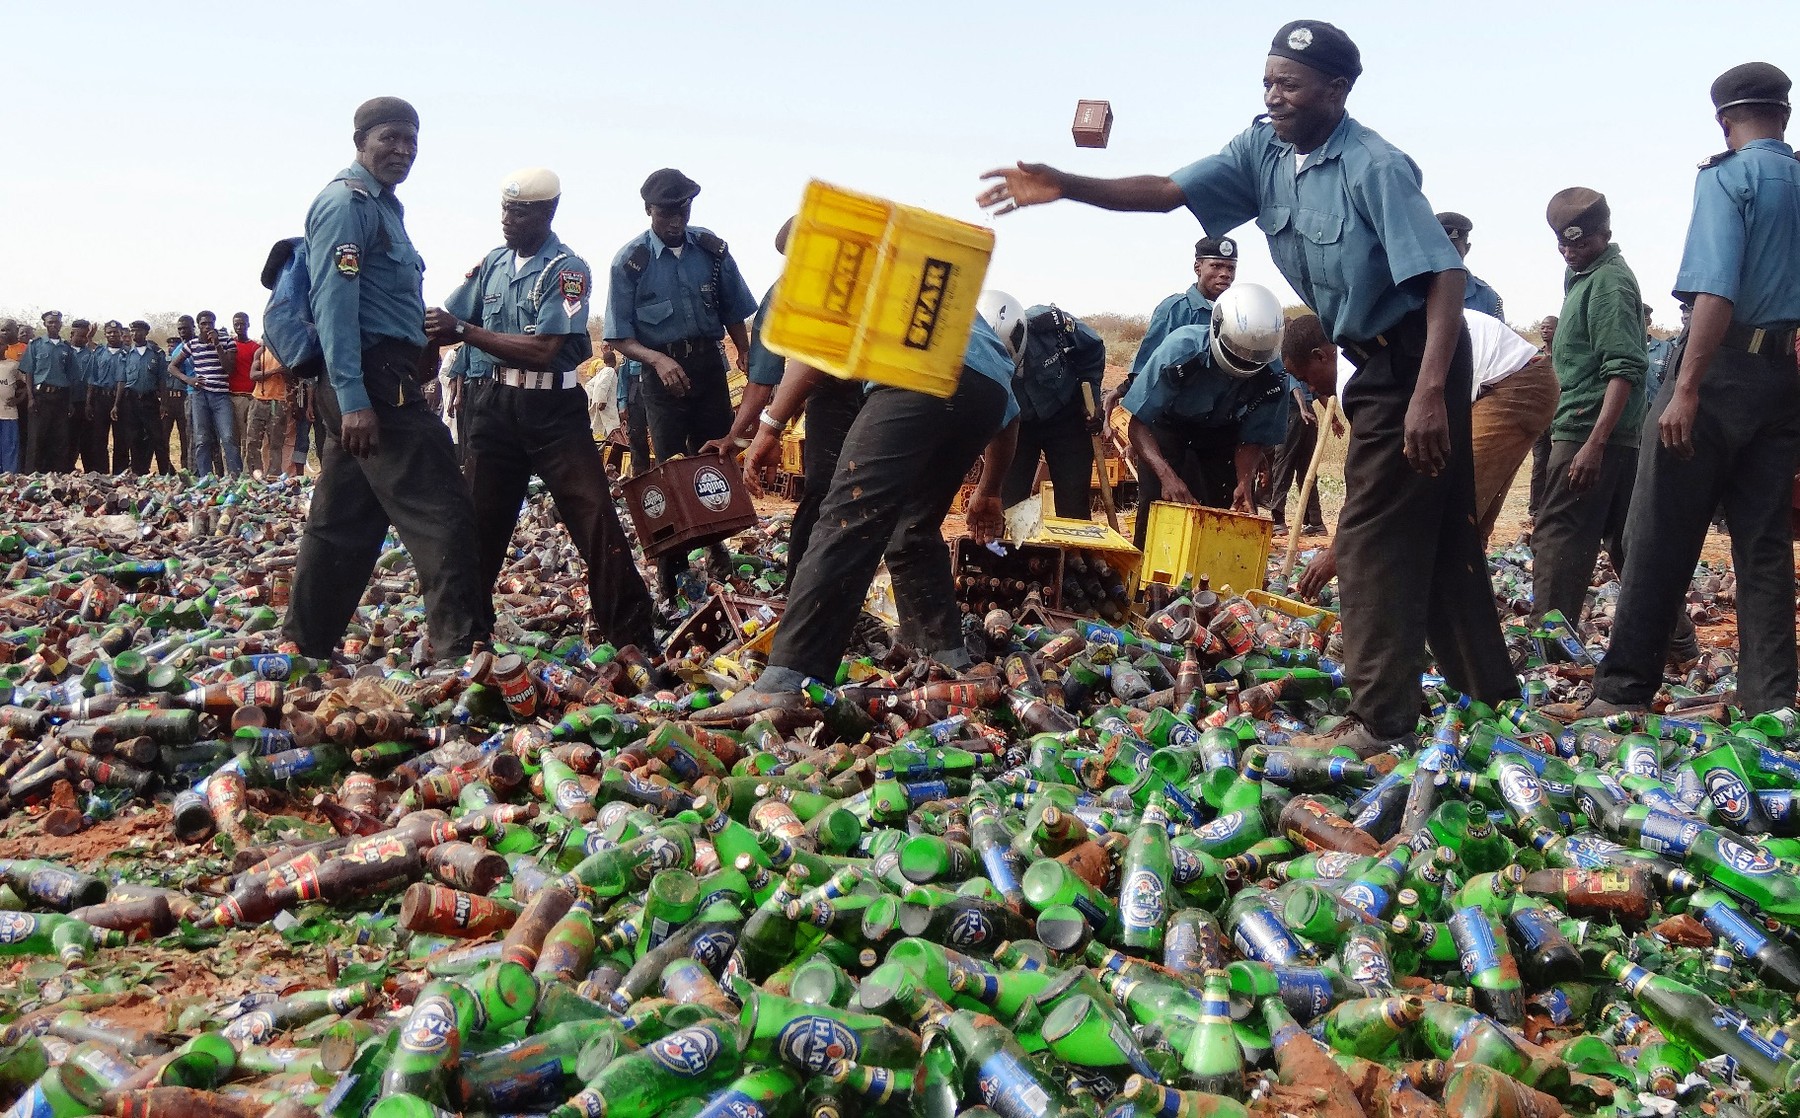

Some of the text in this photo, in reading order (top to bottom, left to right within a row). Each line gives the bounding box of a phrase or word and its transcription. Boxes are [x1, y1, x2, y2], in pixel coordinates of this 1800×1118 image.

[905, 262, 949, 348] STAR
[697, 479, 728, 494] Gulder
[502, 684, 536, 704] Gulder
[1713, 783, 1745, 807] HARP
[1471, 828, 1494, 838] HARP
[808, 1020, 831, 1072] HARP
[985, 1077, 1001, 1106] HARP
